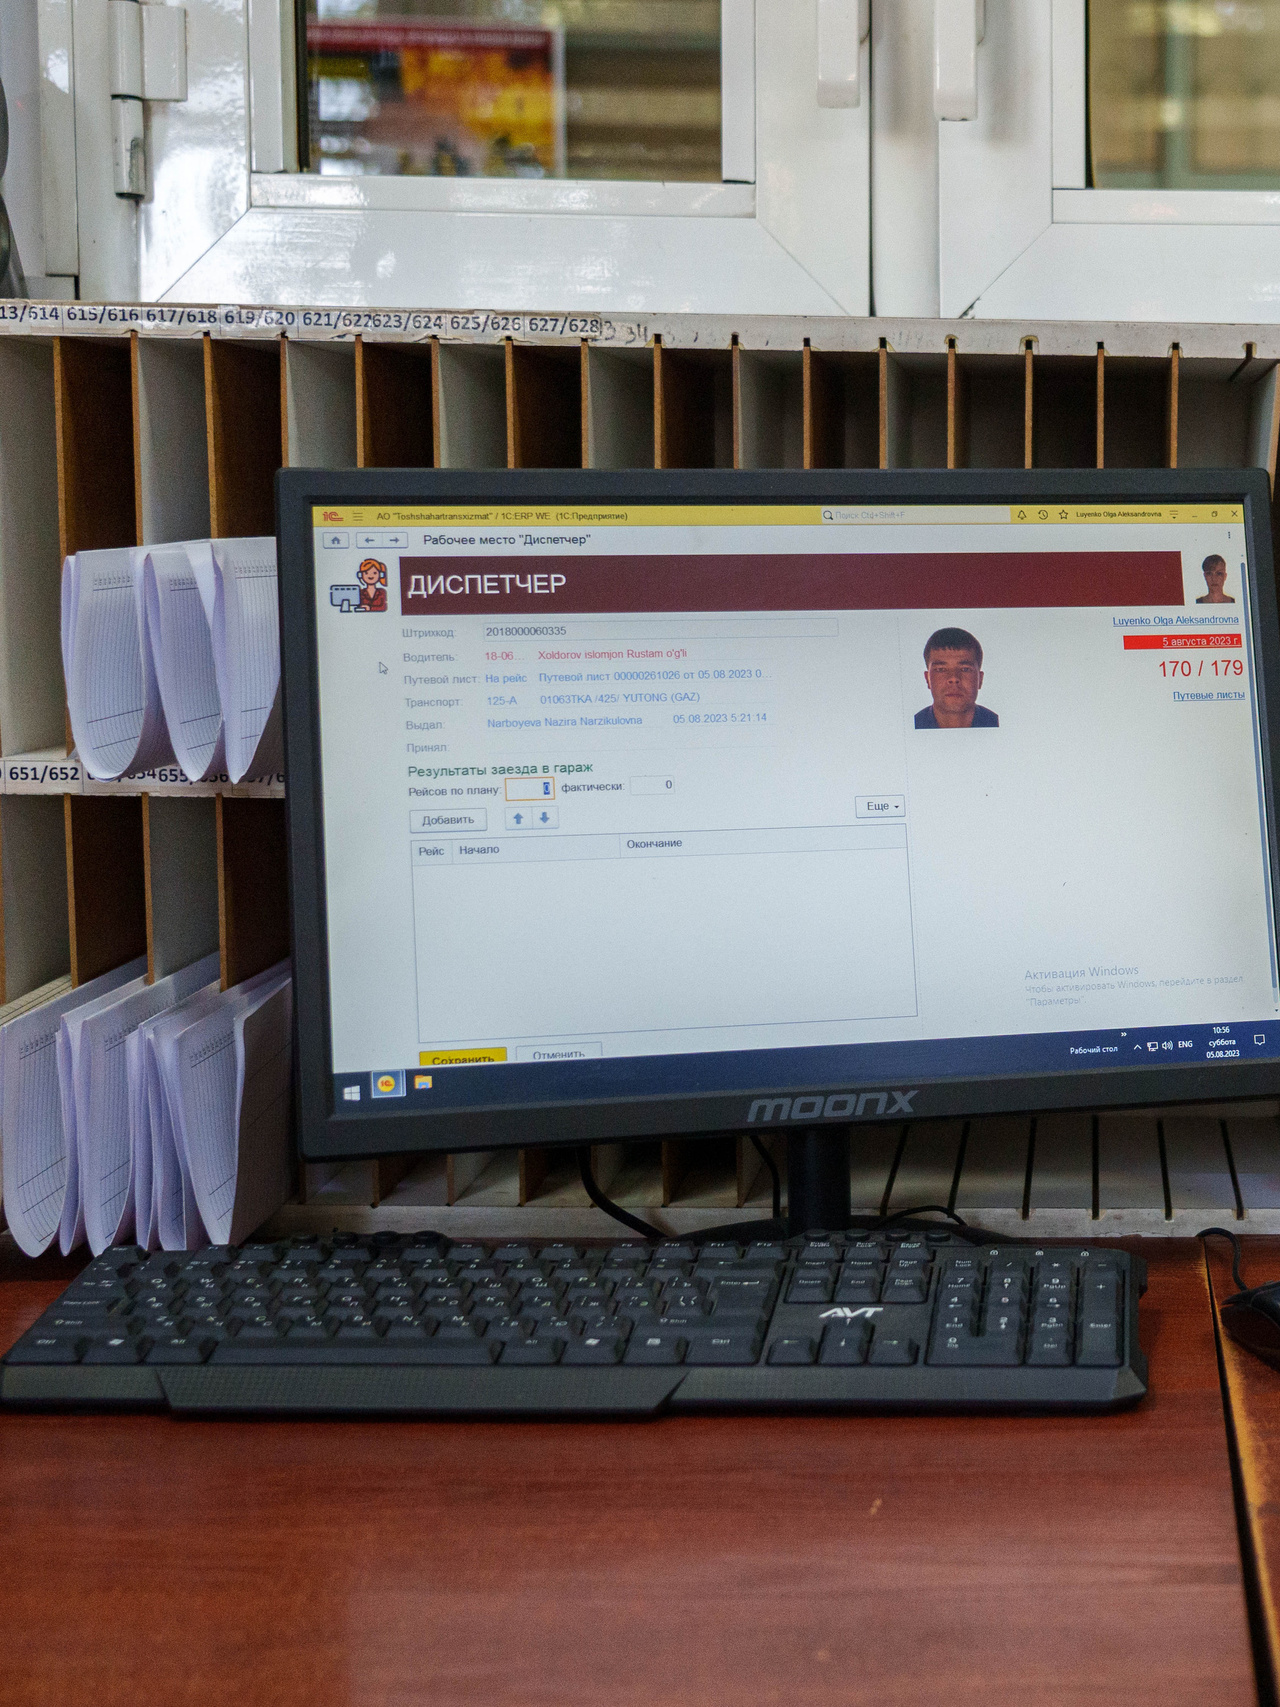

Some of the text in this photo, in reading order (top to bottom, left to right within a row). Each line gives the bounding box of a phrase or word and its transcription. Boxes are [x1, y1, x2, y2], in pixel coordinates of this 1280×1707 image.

[67, 307, 139, 322] 615/616
[146, 309, 217, 325] 617/618
[225, 310, 295, 326] 619/620
[303, 311, 372, 328] 621/622
[373, 312, 443, 330] 623/624
[450, 315, 521, 331] 625/626
[529, 317, 599, 334] 627/628
[1076, 510, 1162, 520] Luyenko Olga Aleksandrovna
[423, 534, 591, 547] Рабочее место "Диспетчер"
[407, 574, 567, 599] ДИСПЕТЧЕР
[1113, 615, 1239, 626] Luyenko Olga Aleksandrovna
[402, 626, 567, 639] Штрихкод: 2018000060335
[1171, 637, 1231, 647] августа 2023
[403, 652, 458, 663] Водитель:
[538, 649, 582, 660] Xoldorov
[626, 648, 664, 659] Rustam
[1159, 659, 1244, 677] 170 179
[403, 674, 450, 686] Путевой
[502, 675, 528, 686] рейс
[539, 672, 583, 684] Путевой
[586, 673, 611, 683] лист
[614, 671, 681, 681] 00000261026
[698, 669, 753, 680] 05.08.2023
[405, 697, 463, 709] Транспорт:
[623, 692, 667, 703] YUTONG
[670, 692, 701, 704] (GAZ)
[1173, 691, 1246, 701] Путевые листы
[406, 713, 767, 732] Выдал: Narboyeva Nazira Narzikulovna 05.08.2023 5:21:14
[406, 742, 449, 754] Принял:
[9, 765, 80, 783] 651/652
[408, 764, 594, 779] Результаты заезда гараж
[408, 781, 626, 799] Рейсов по плану: фактически:
[867, 801, 890, 813] Еще
[422, 815, 475, 827] Добавить
[418, 838, 683, 857] Рейс Начало Окончание
[1025, 965, 1139, 982] Активация Windows
[1212, 1026, 1230, 1034] 10:56
[1178, 1040, 1193, 1049] ENG
[1208, 1037, 1236, 1047] суббота
[1070, 1045, 1101, 1055] Рабочий
[1206, 1050, 1240, 1059] 05.08.2023
[747, 1090, 920, 1122] moonx
